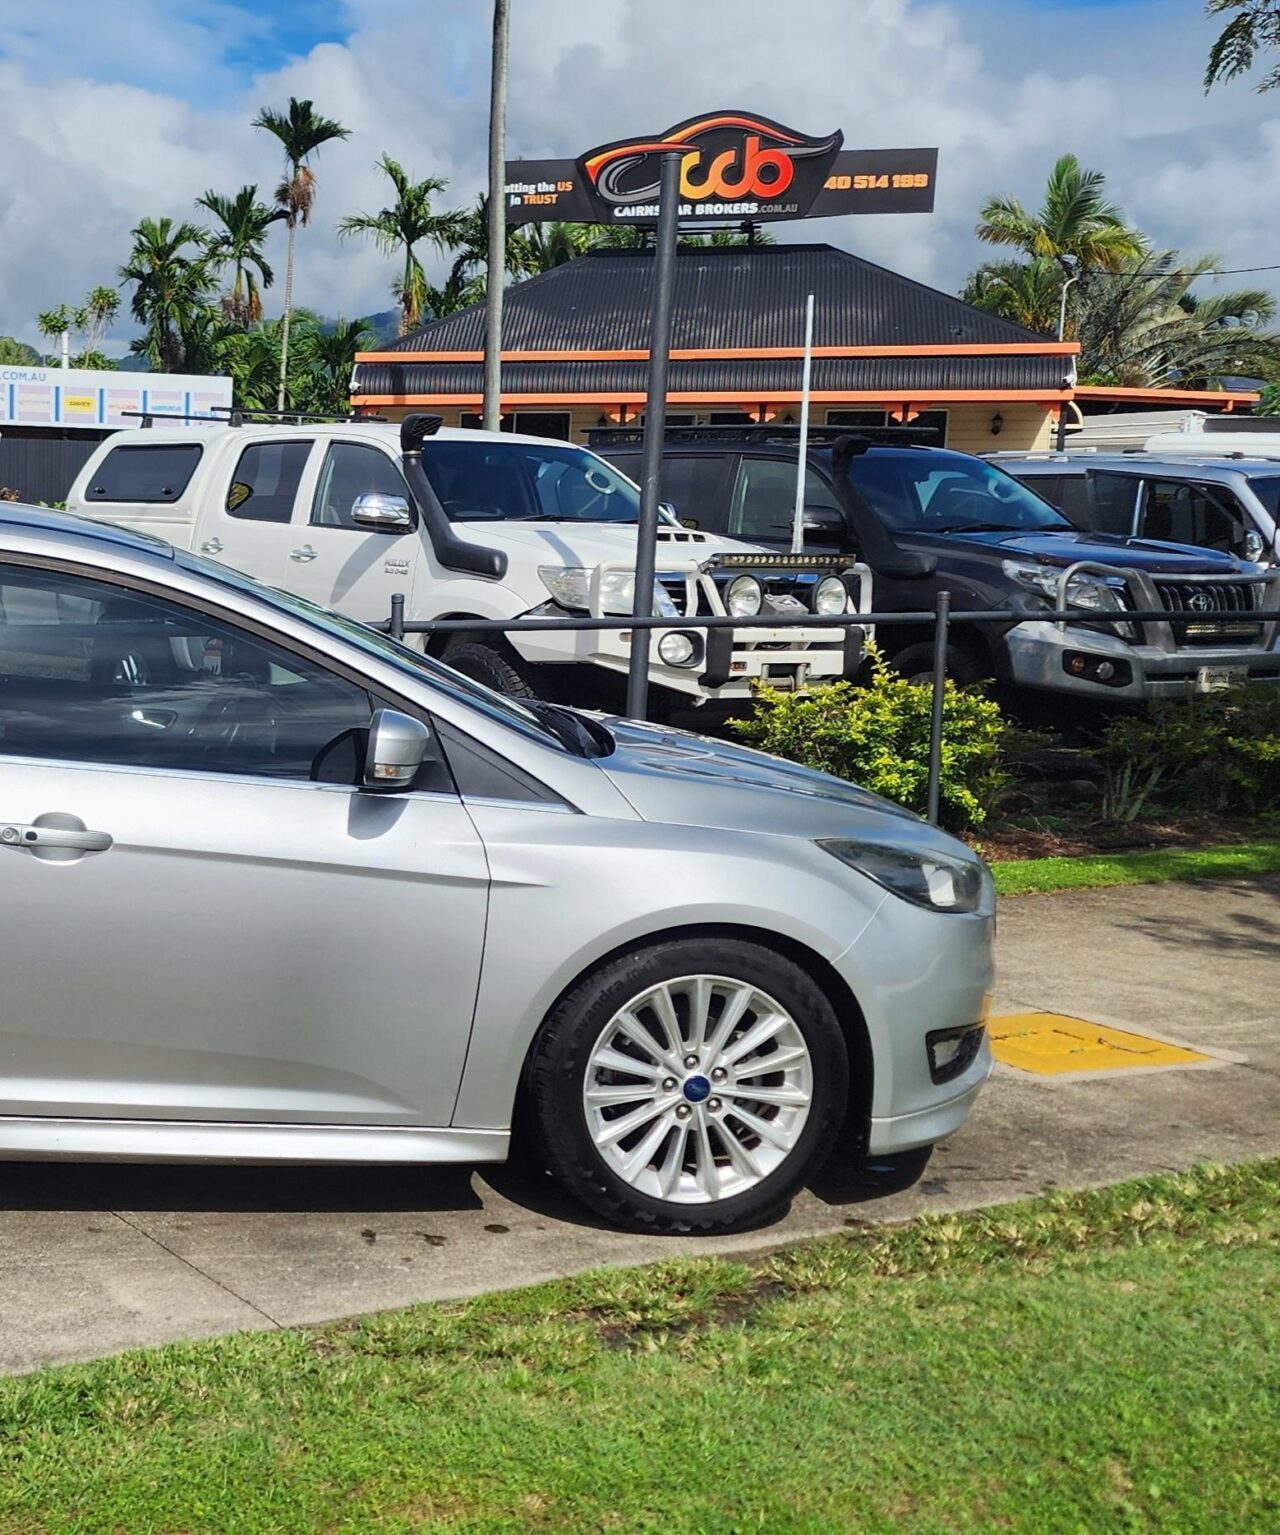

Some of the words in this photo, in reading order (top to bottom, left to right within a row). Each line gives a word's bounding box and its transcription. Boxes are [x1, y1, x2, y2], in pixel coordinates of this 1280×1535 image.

[503, 182, 536, 195] utting
[537, 181, 556, 192] the
[557, 181, 573, 192] US
[823, 176, 851, 190] 40
[854, 175, 889, 189] 514
[892, 173, 929, 188] 199
[510, 195, 521, 207] in
[523, 194, 558, 206] TRUST
